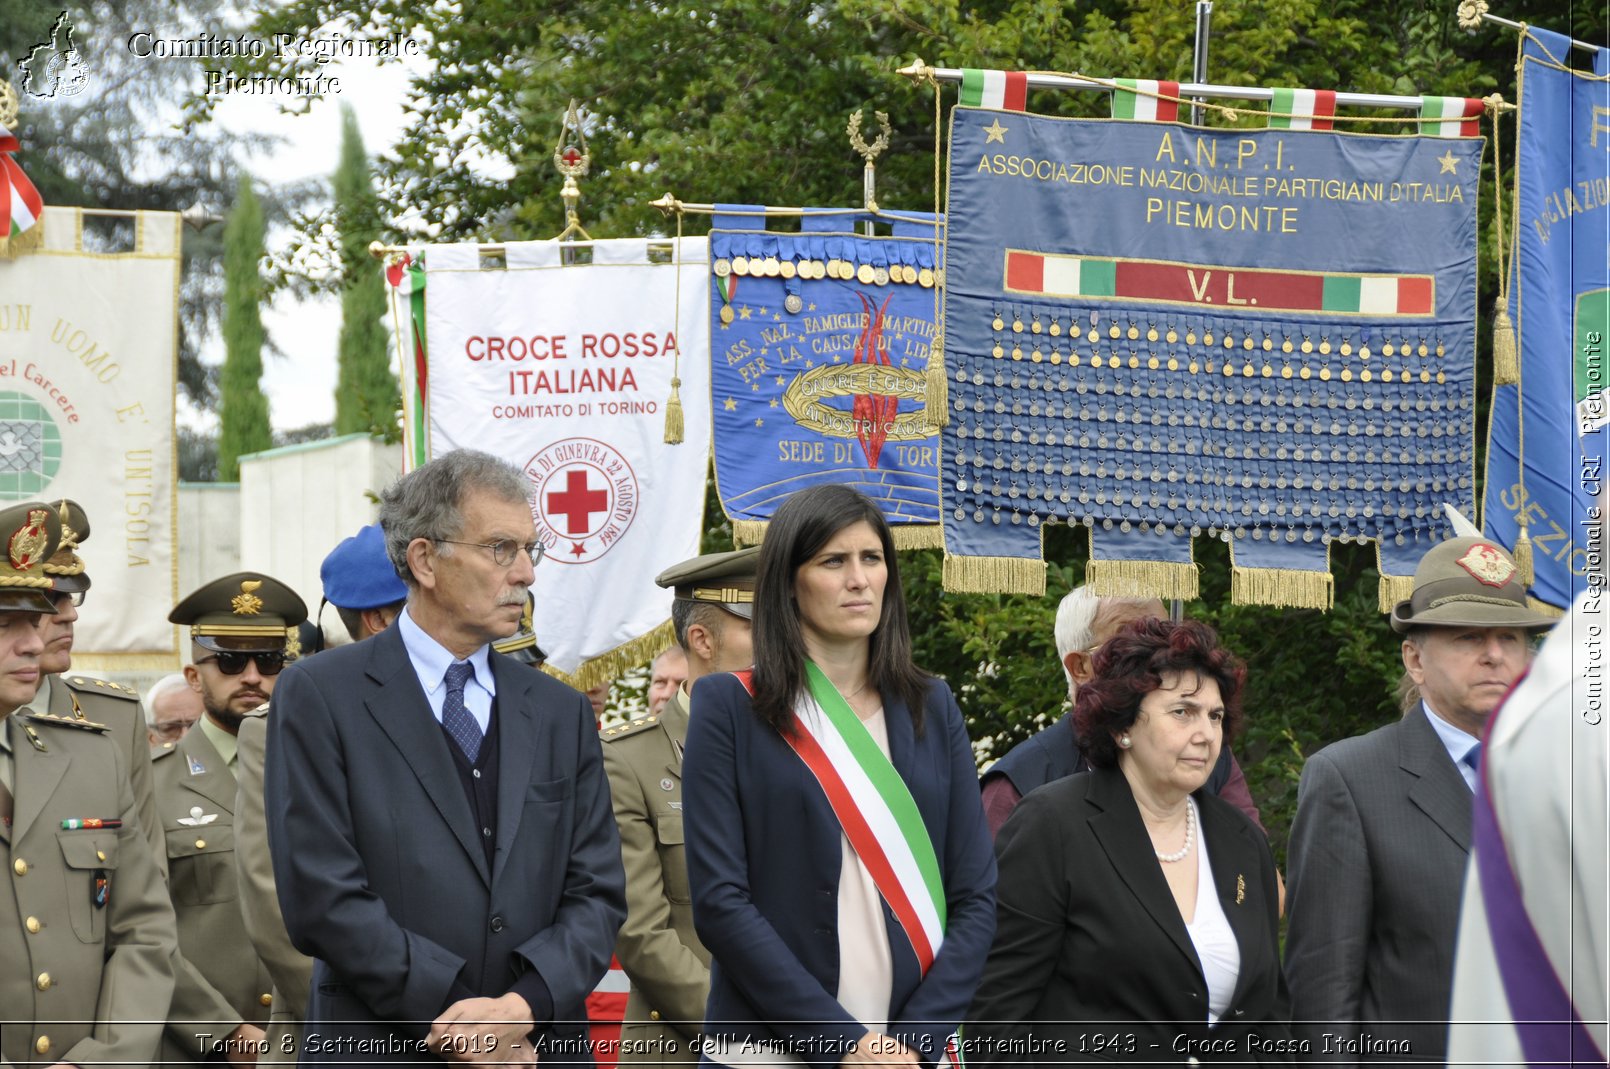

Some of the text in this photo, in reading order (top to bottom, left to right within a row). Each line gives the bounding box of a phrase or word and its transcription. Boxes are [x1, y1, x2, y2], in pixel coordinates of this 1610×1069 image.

[1155, 132, 1295, 171] A.N.P.I.
[977, 154, 1464, 203] ASSOCIAZIONE NAZIONALE PARTIGIANI D'ITALIA
[1146, 198, 1298, 233] PIEMONTE
[1187, 269, 1258, 305] V. L.
[465, 332, 680, 362] CROCE ROSSA
[725, 338, 755, 366] ASS.
[760, 323, 796, 346] NAZ.
[803, 312, 870, 335] FAMIGLIE
[738, 357, 770, 384] PER
[779, 345, 804, 365] LA
[811, 335, 864, 354] CAUSA
[877, 335, 893, 351] DI
[24, 362, 79, 424] Carcere
[509, 367, 639, 395] ITALIANA
[801, 372, 858, 396] ONORE
[868, 373, 878, 390] E
[492, 401, 657, 419] COMITATO DI TORINO
[805, 405, 819, 420] AI
[822, 414, 877, 434] NOSTRI
[50, 317, 121, 384] UOMO
[124, 448, 152, 568] UN'ISOLA
[555, 443, 607, 466] GINEVRA
[778, 440, 825, 463] SEDE
[834, 443, 853, 464] DI
[537, 453, 555, 472] DI
[606, 459, 623, 476] 22
[615, 476, 633, 522] AGOSTO
[600, 523, 621, 547] 1864
